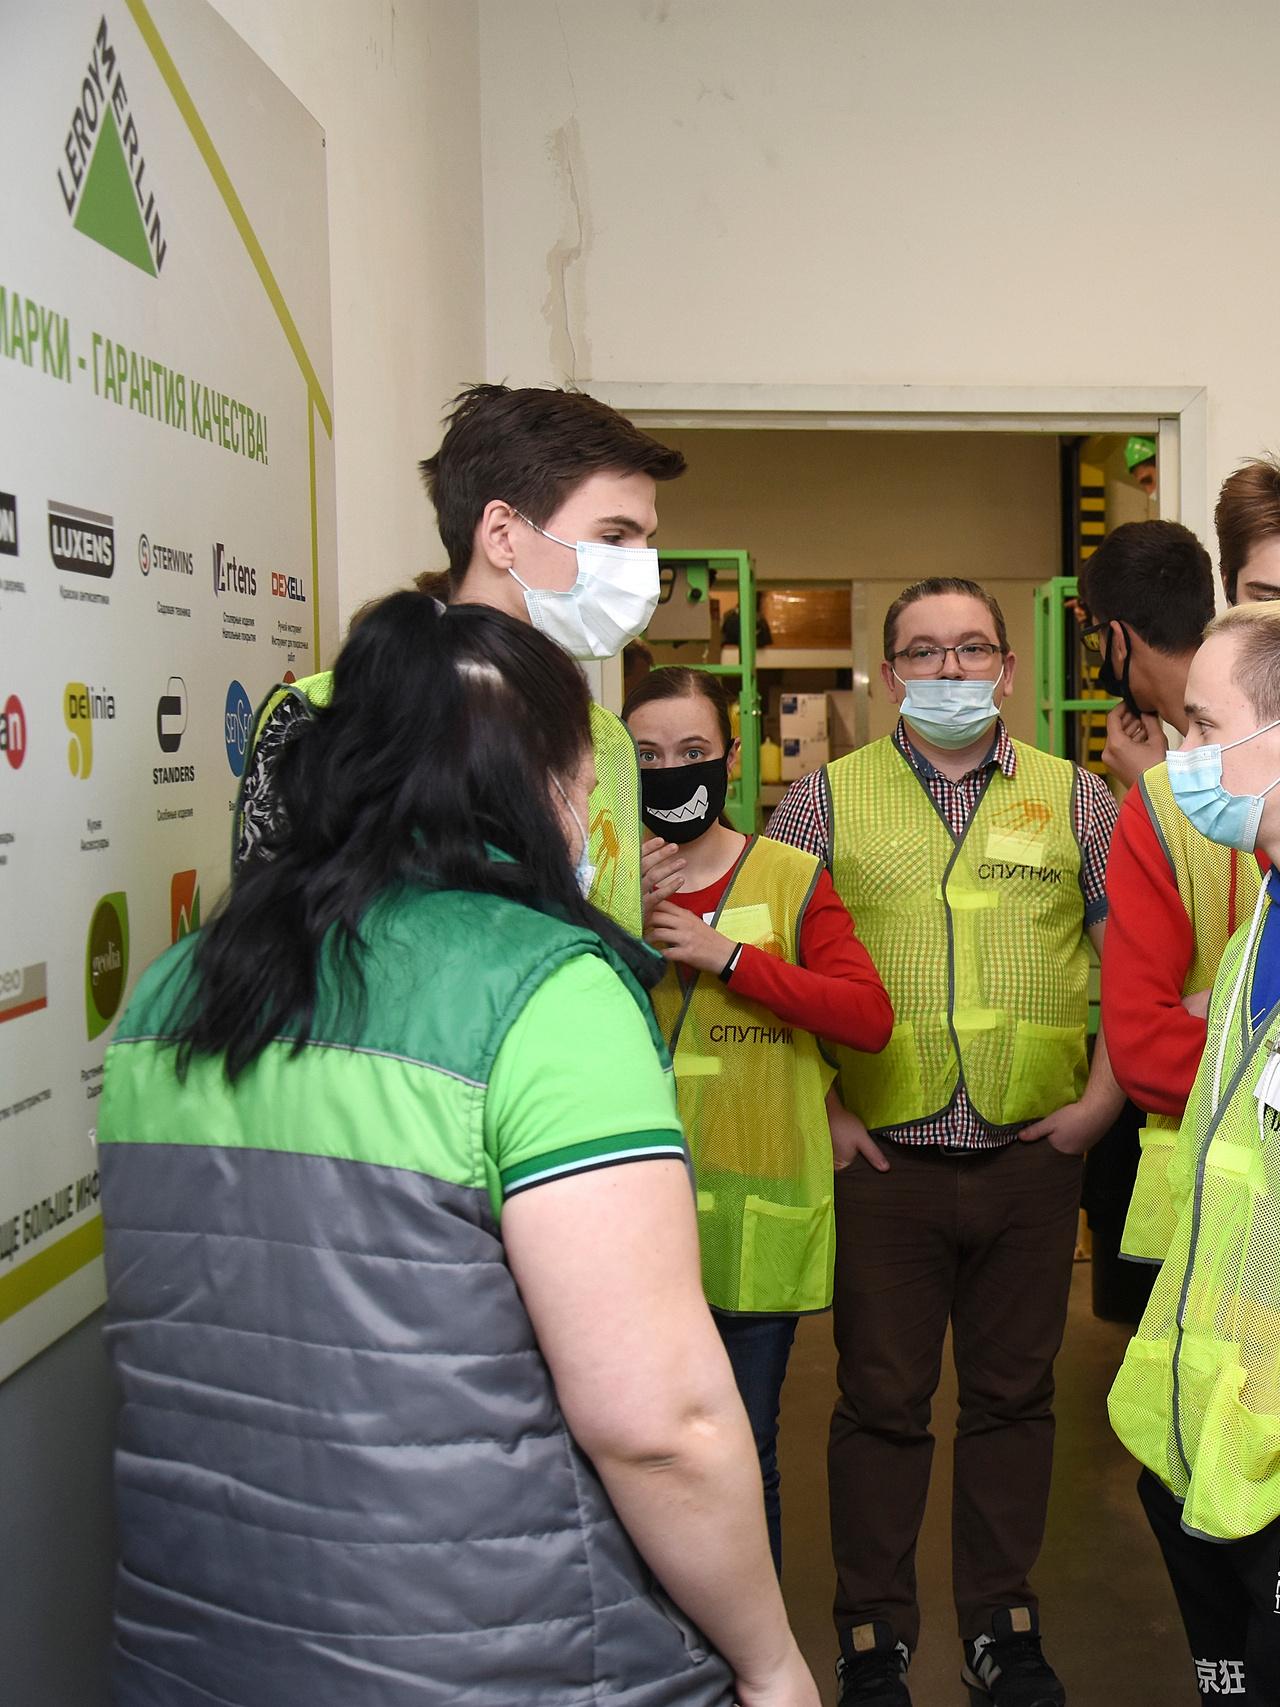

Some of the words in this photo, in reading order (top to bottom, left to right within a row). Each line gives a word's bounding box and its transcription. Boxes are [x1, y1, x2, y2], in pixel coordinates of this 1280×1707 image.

[58, 46, 104, 217] LEROY
[97, 14, 167, 273] MERLIN
[92, 331, 187, 432] ГАРАНТИЯ
[191, 380, 268, 466] КАЧЕСТВА!
[52, 524, 112, 566] LUXENS
[152, 544, 194, 576] STERWINS
[212, 542, 257, 598] Artens
[271, 571, 306, 602] DEXELL
[153, 766, 195, 785] STANDERS
[978, 863, 1062, 884] СПУТНИК
[710, 1025, 794, 1044] СПУТНИК
[23, 1184, 73, 1245] БОЛЬШЕ
[1192, 1658, 1246, 1694] 京狂
